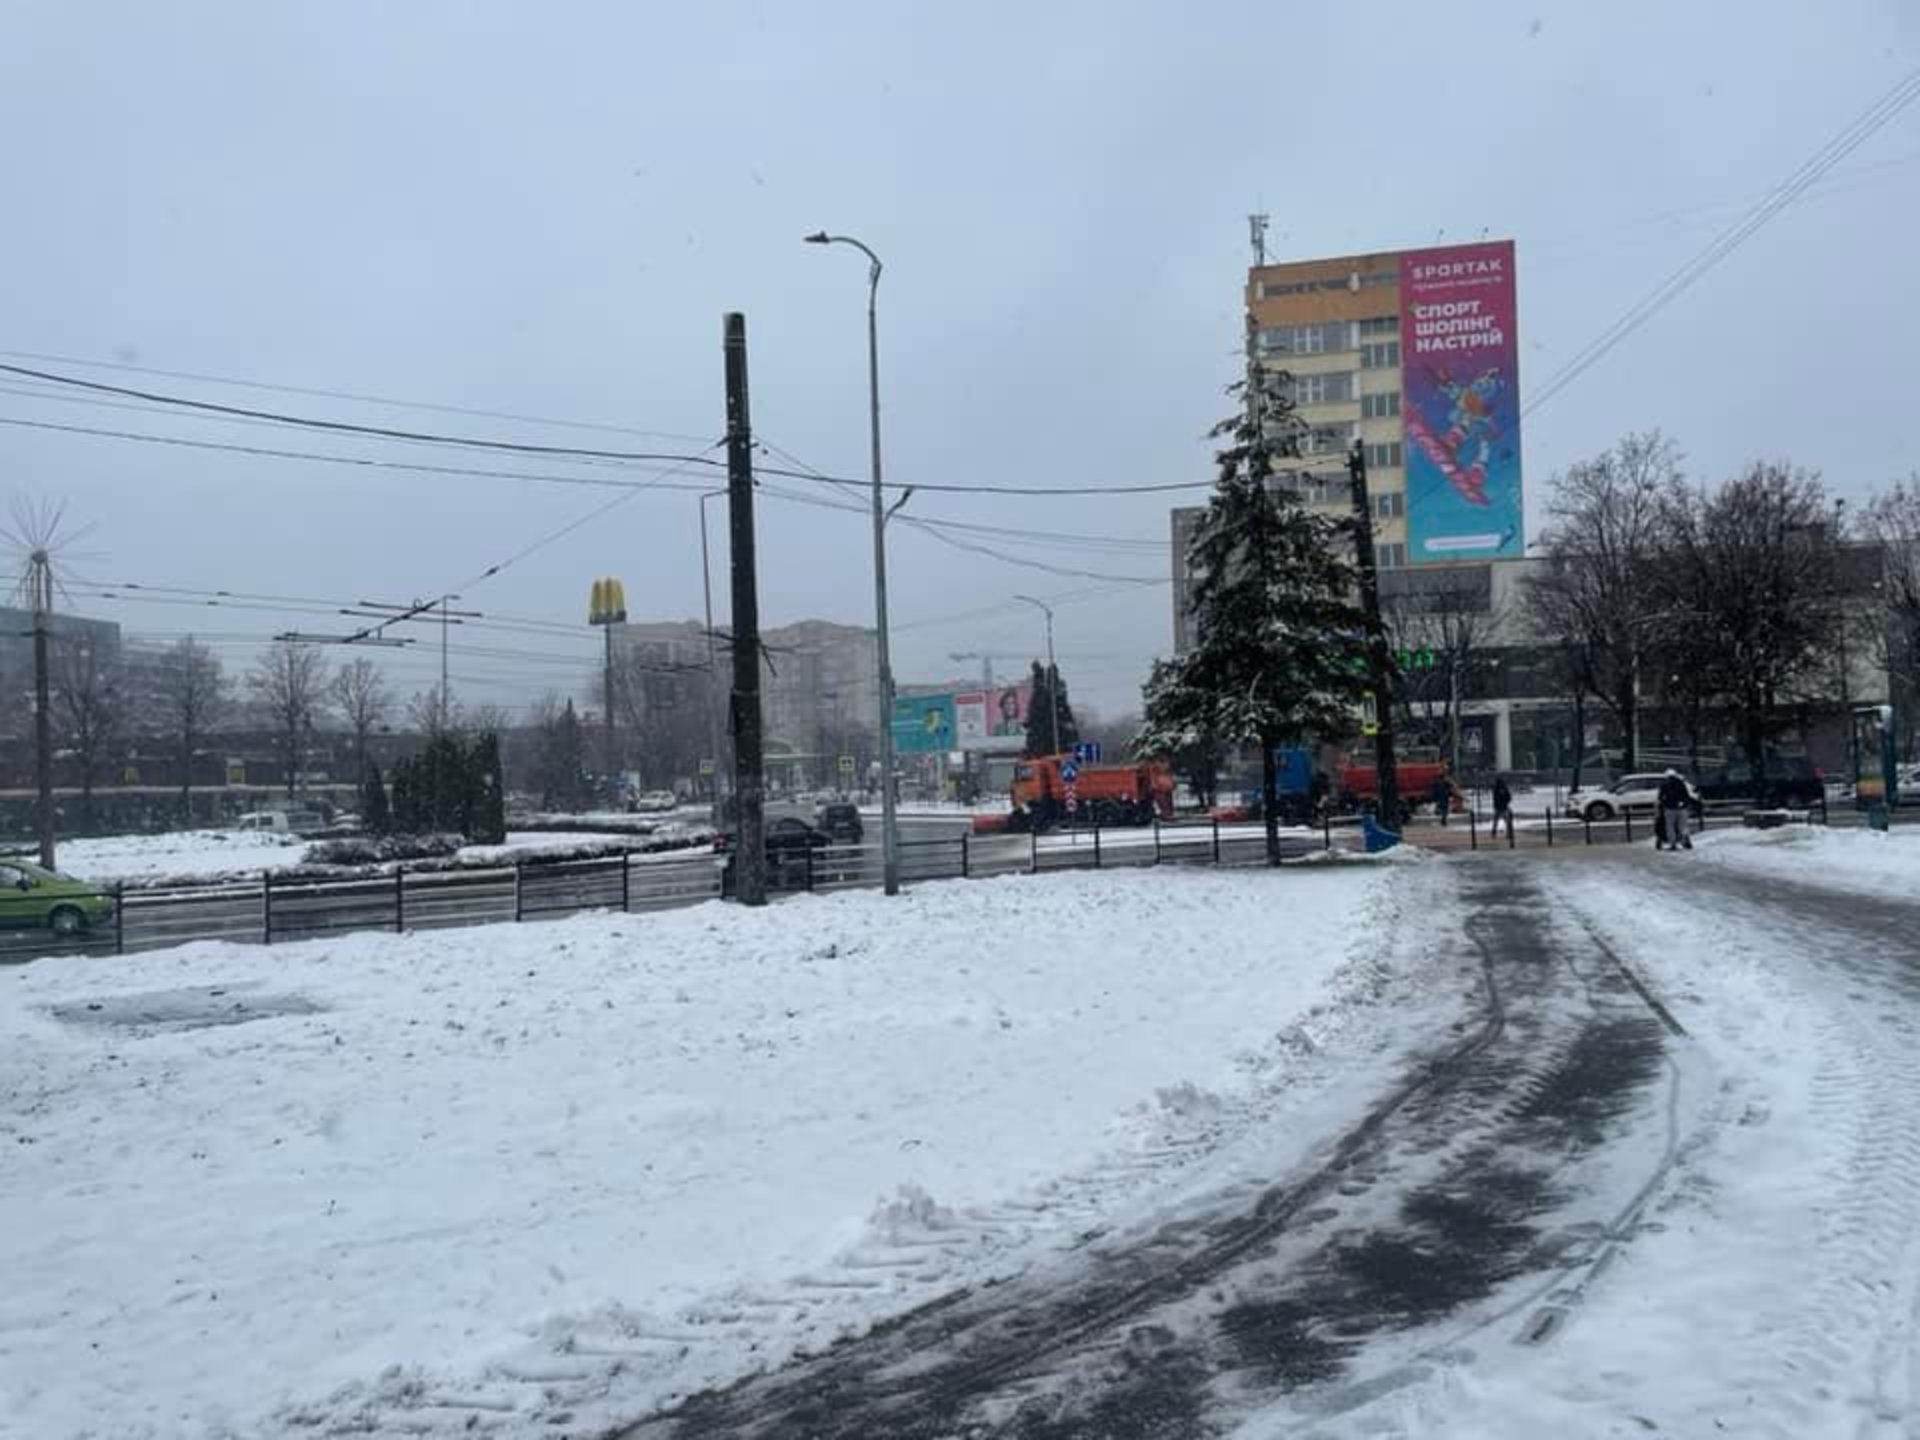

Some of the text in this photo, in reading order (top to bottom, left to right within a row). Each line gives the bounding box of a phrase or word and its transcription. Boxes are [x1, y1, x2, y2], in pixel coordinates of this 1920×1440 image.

[1413, 259, 1502, 279] SPORTAK
[1415, 300, 1481, 319] СПОРТ
[1415, 315, 1495, 336] ШОПІНГ
[1416, 327, 1503, 352] НАСТРІЙ
